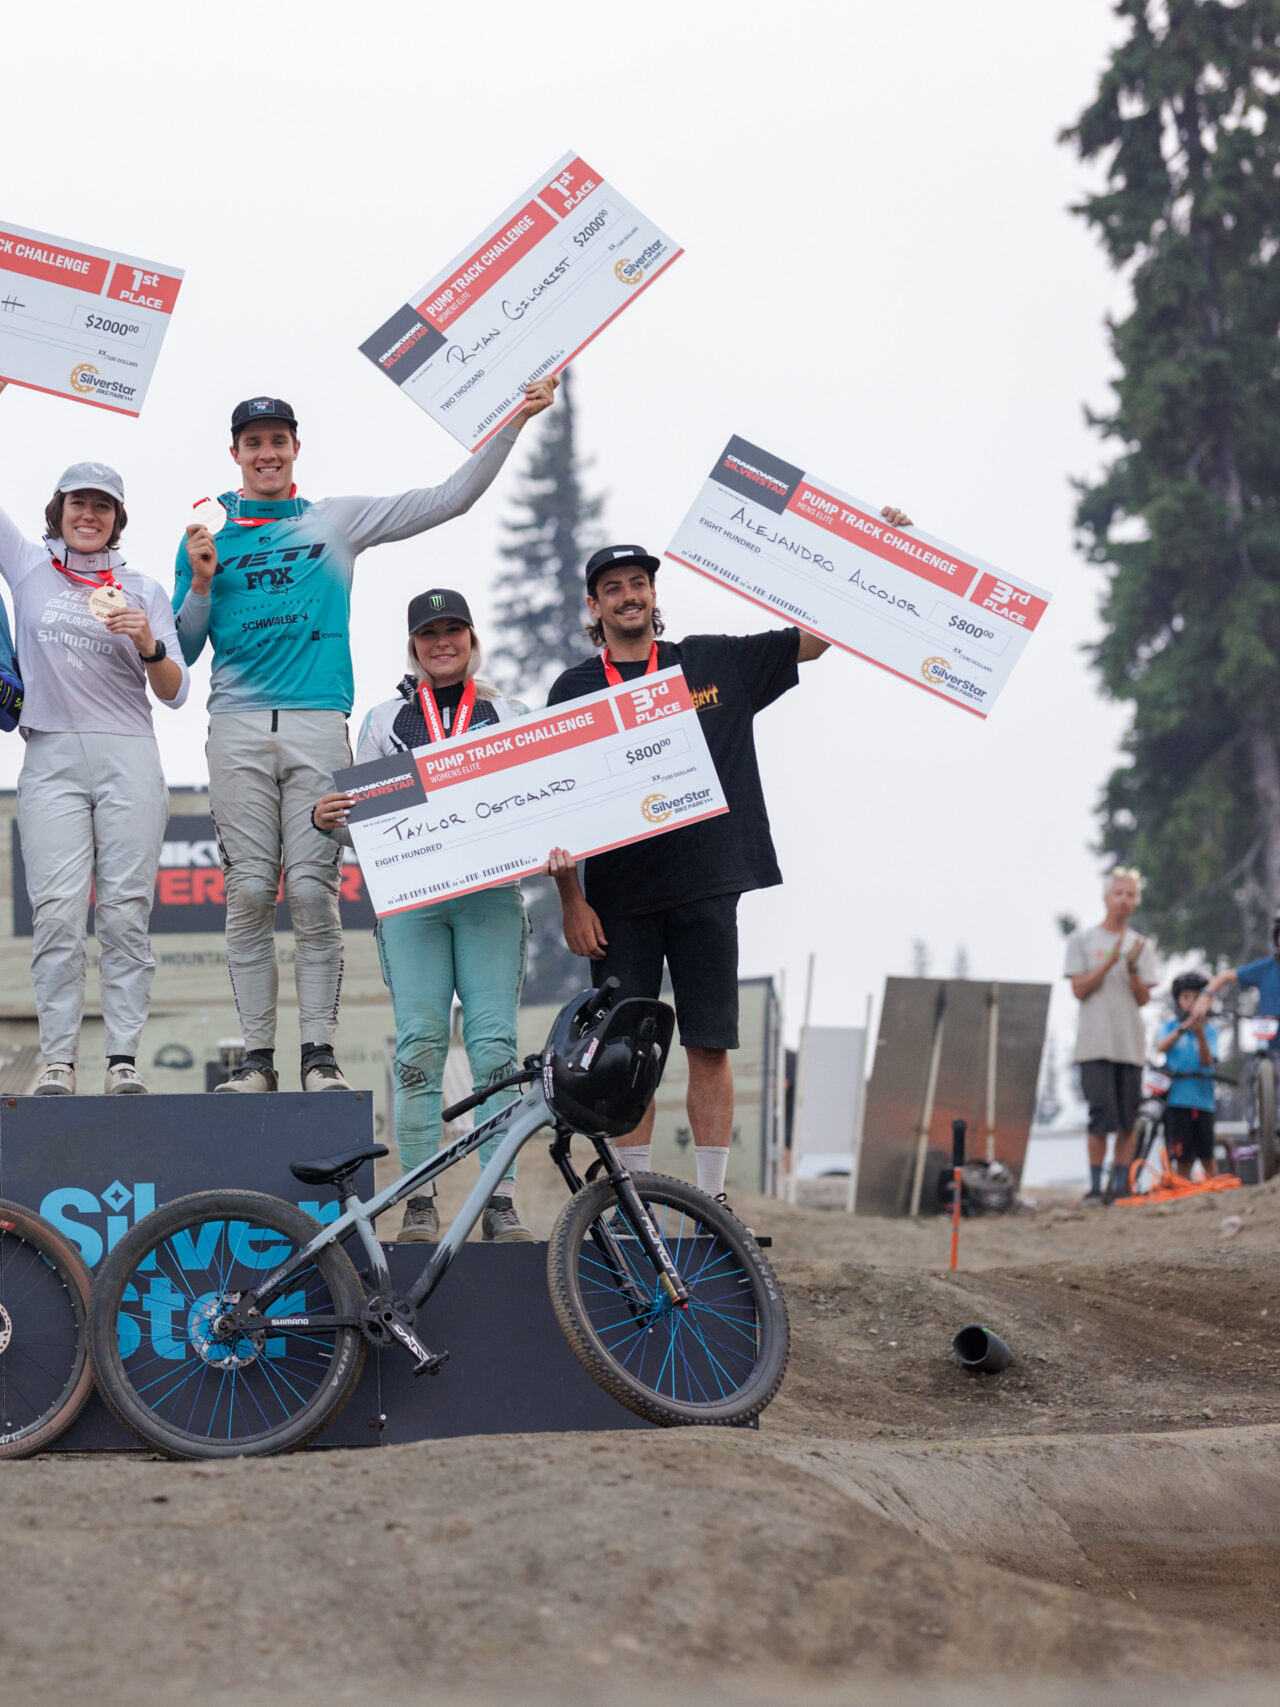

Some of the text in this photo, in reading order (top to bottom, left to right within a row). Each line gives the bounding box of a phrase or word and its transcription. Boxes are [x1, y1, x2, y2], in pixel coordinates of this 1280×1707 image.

[549, 170, 578, 198] 1st
[563, 179, 595, 209] PLACE
[15, 243, 90, 274] CHALLENGE
[425, 214, 535, 317] PUMP TRACK CHALLENGE
[622, 238, 663, 277] SilverStar
[129, 269, 160, 294] 1st
[119, 289, 163, 309] PLACE
[455, 290, 471, 305] ELITE
[79, 372, 136, 396] SilverStar
[439, 395, 456, 411] TWO
[453, 368, 485, 399] THOUSAND
[722, 459, 787, 496] SILVERSTAR
[796, 501, 834, 524] MENS ELITE
[698, 516, 761, 554] EIGHT HUNDRED
[800, 490, 957, 575] PUMP TRACK CHALLENGE
[214, 543, 326, 576] YETI
[244, 566, 294, 593] FOX
[988, 580, 1031, 609] 3rd
[241, 613, 299, 632] SCHWALBE
[982, 597, 1026, 625] PLACE
[37, 630, 113, 655] SHIMANO
[930, 664, 987, 698] SilverStar
[630, 681, 671, 712] 3rd
[635, 701, 681, 724] PLACE
[425, 711, 594, 774] PUMP TRACK CHALLENGE
[429, 762, 481, 783] WOMENS ELITE
[351, 776, 414, 804] ILVERSTAR
[650, 787, 711, 814] SilverStar
[374, 841, 442, 868] EIGHT HUNDRED
[743, 1240, 778, 1301] KENDA
[271, 1318, 309, 1326] SHIMANO
[331, 1332, 352, 1387] ENDA
